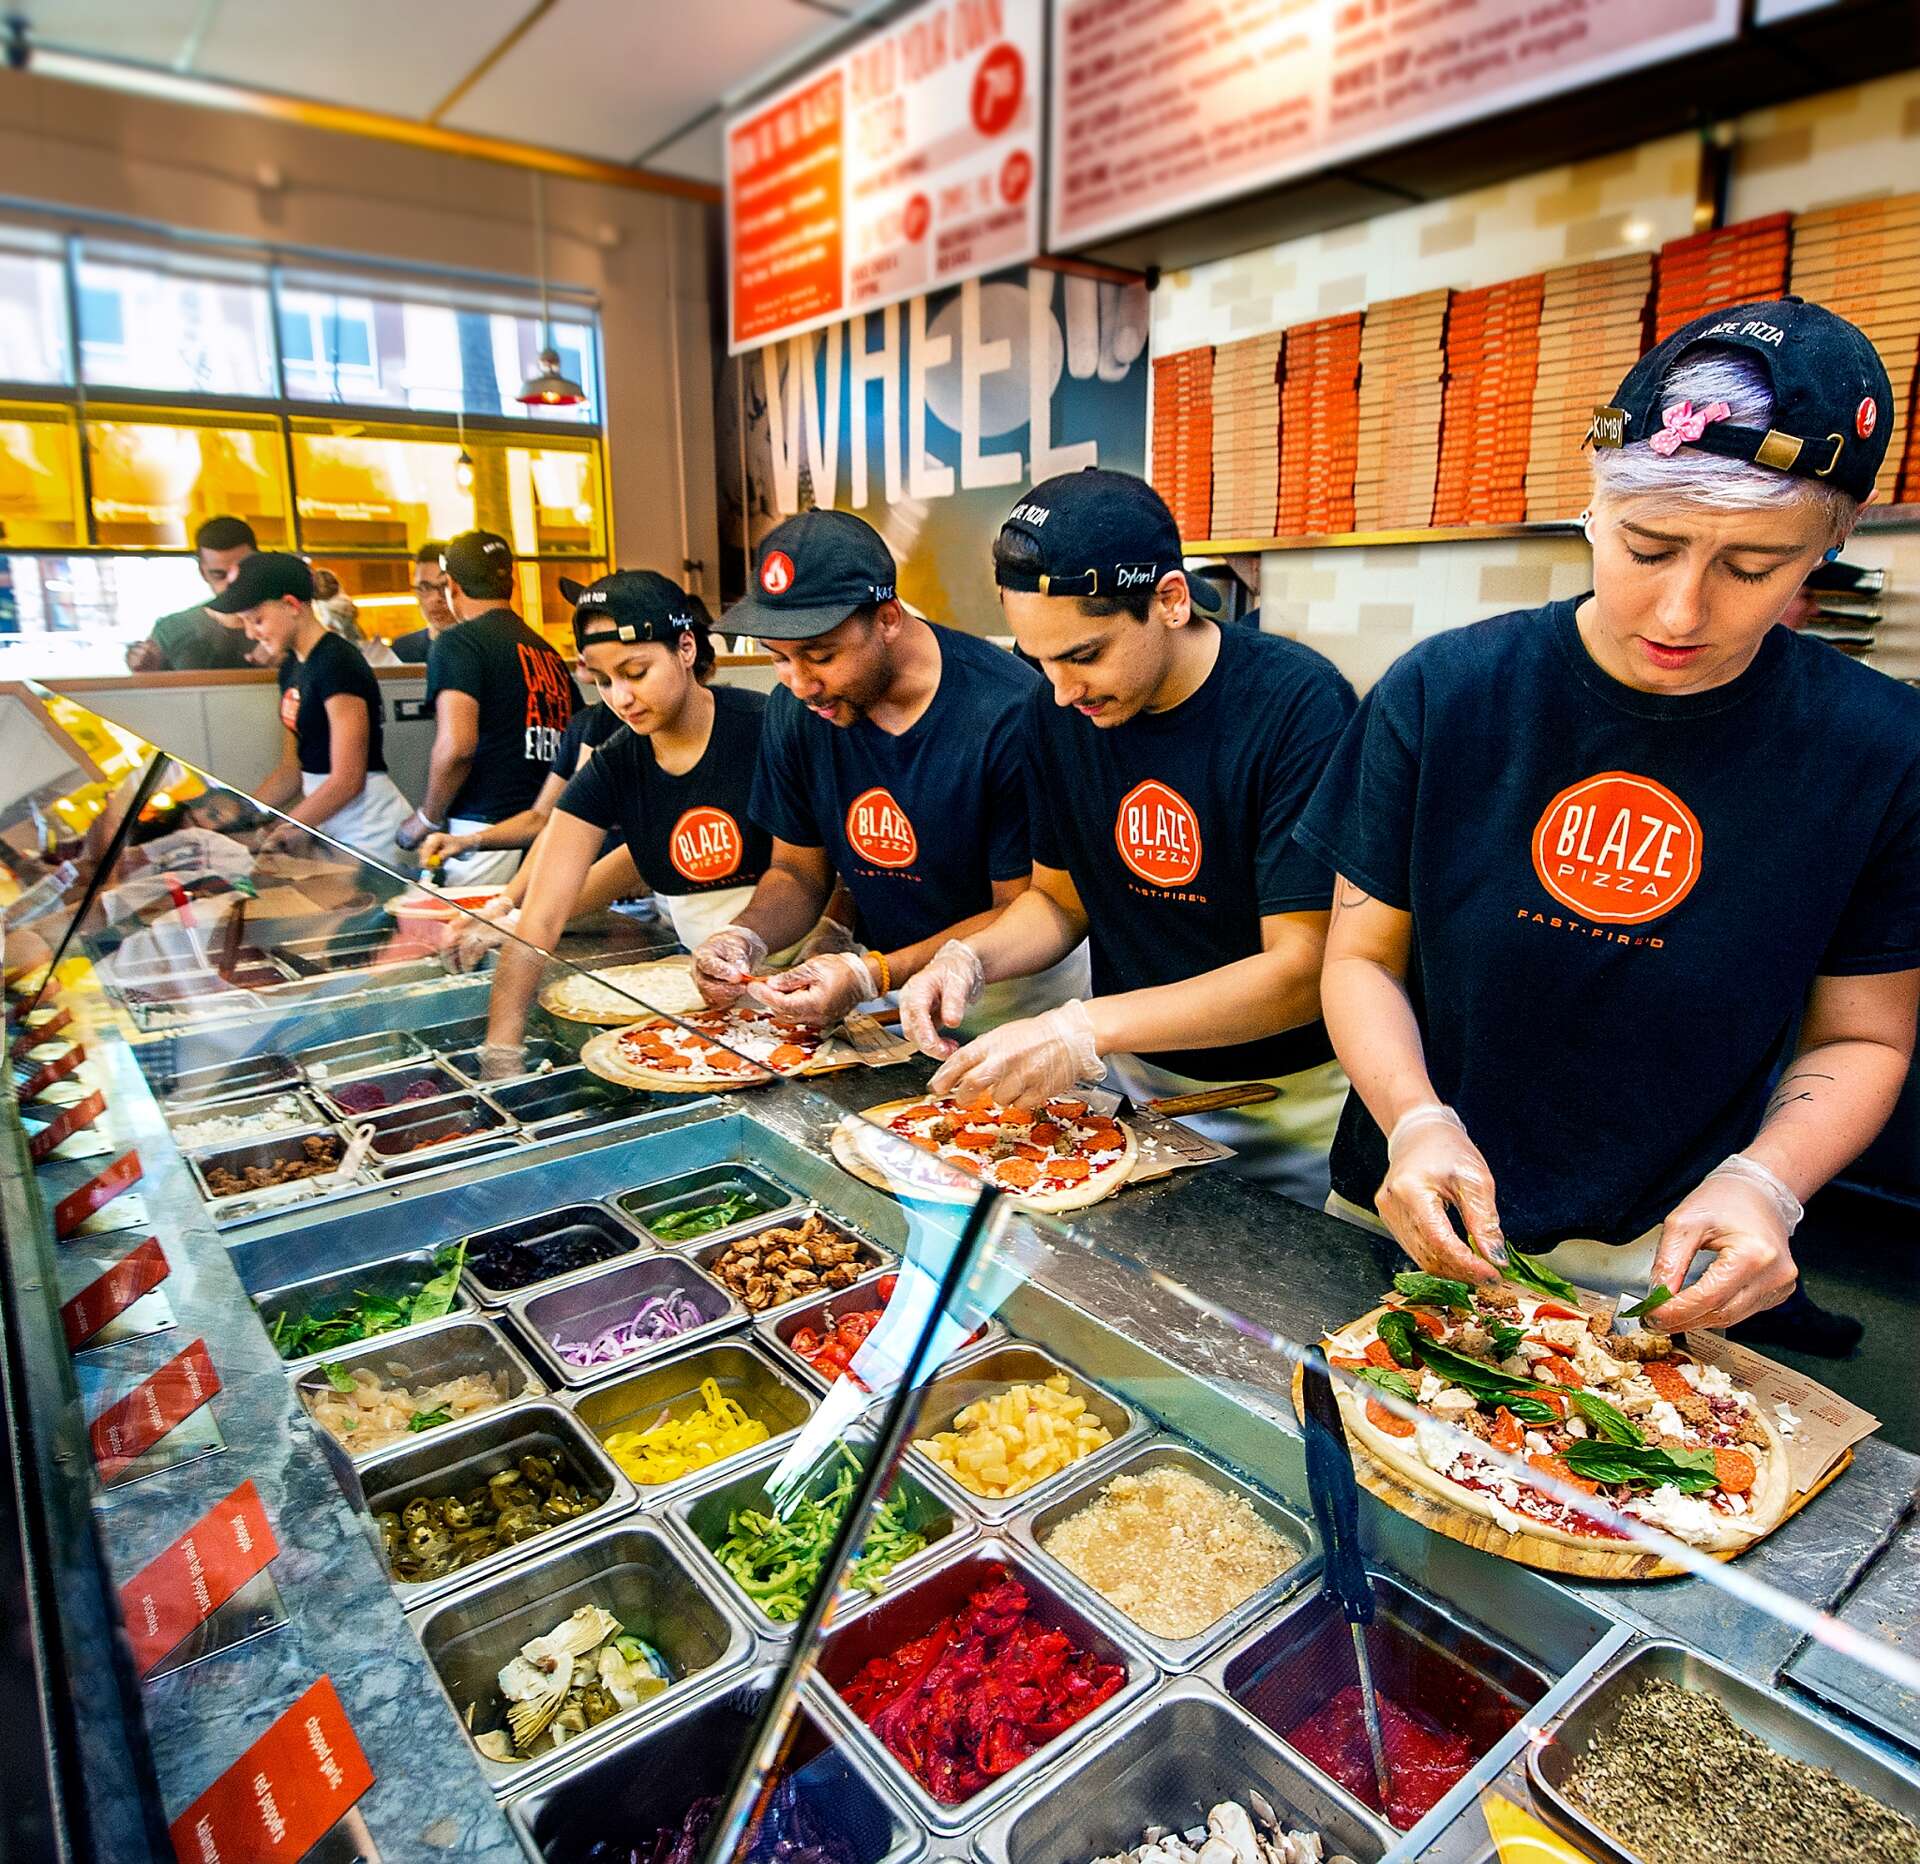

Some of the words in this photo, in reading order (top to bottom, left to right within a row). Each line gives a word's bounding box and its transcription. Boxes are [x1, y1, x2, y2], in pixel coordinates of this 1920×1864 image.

[1739, 320, 1785, 348] PIZZA
[762, 267, 1098, 515] WHEEL
[1593, 414, 1623, 444] KIMBY
[875, 585, 894, 602] KAI
[1116, 564, 1158, 589] Dylan!
[677, 821, 732, 863] BLAZE
[858, 806, 911, 844] BLAZE
[1128, 804, 1191, 853] BLAZE
[1555, 804, 1682, 878] BLAZE
[690, 852, 732, 871] PIZZA
[862, 838, 911, 853] PIZZA
[1134, 848, 1191, 866] PIZZA
[1557, 863, 1659, 898] PIZZA
[230, 1514, 256, 1553] pineapple
[181, 1538, 199, 1567] green
[189, 1562, 204, 1579] bell
[191, 1575, 213, 1613] peppers
[142, 1593, 160, 1637] artichokes
[304, 1715, 334, 1761] chopped
[319, 1757, 345, 1791] garlic
[253, 1771, 273, 1797] red
[258, 1790, 287, 1845] peppers
